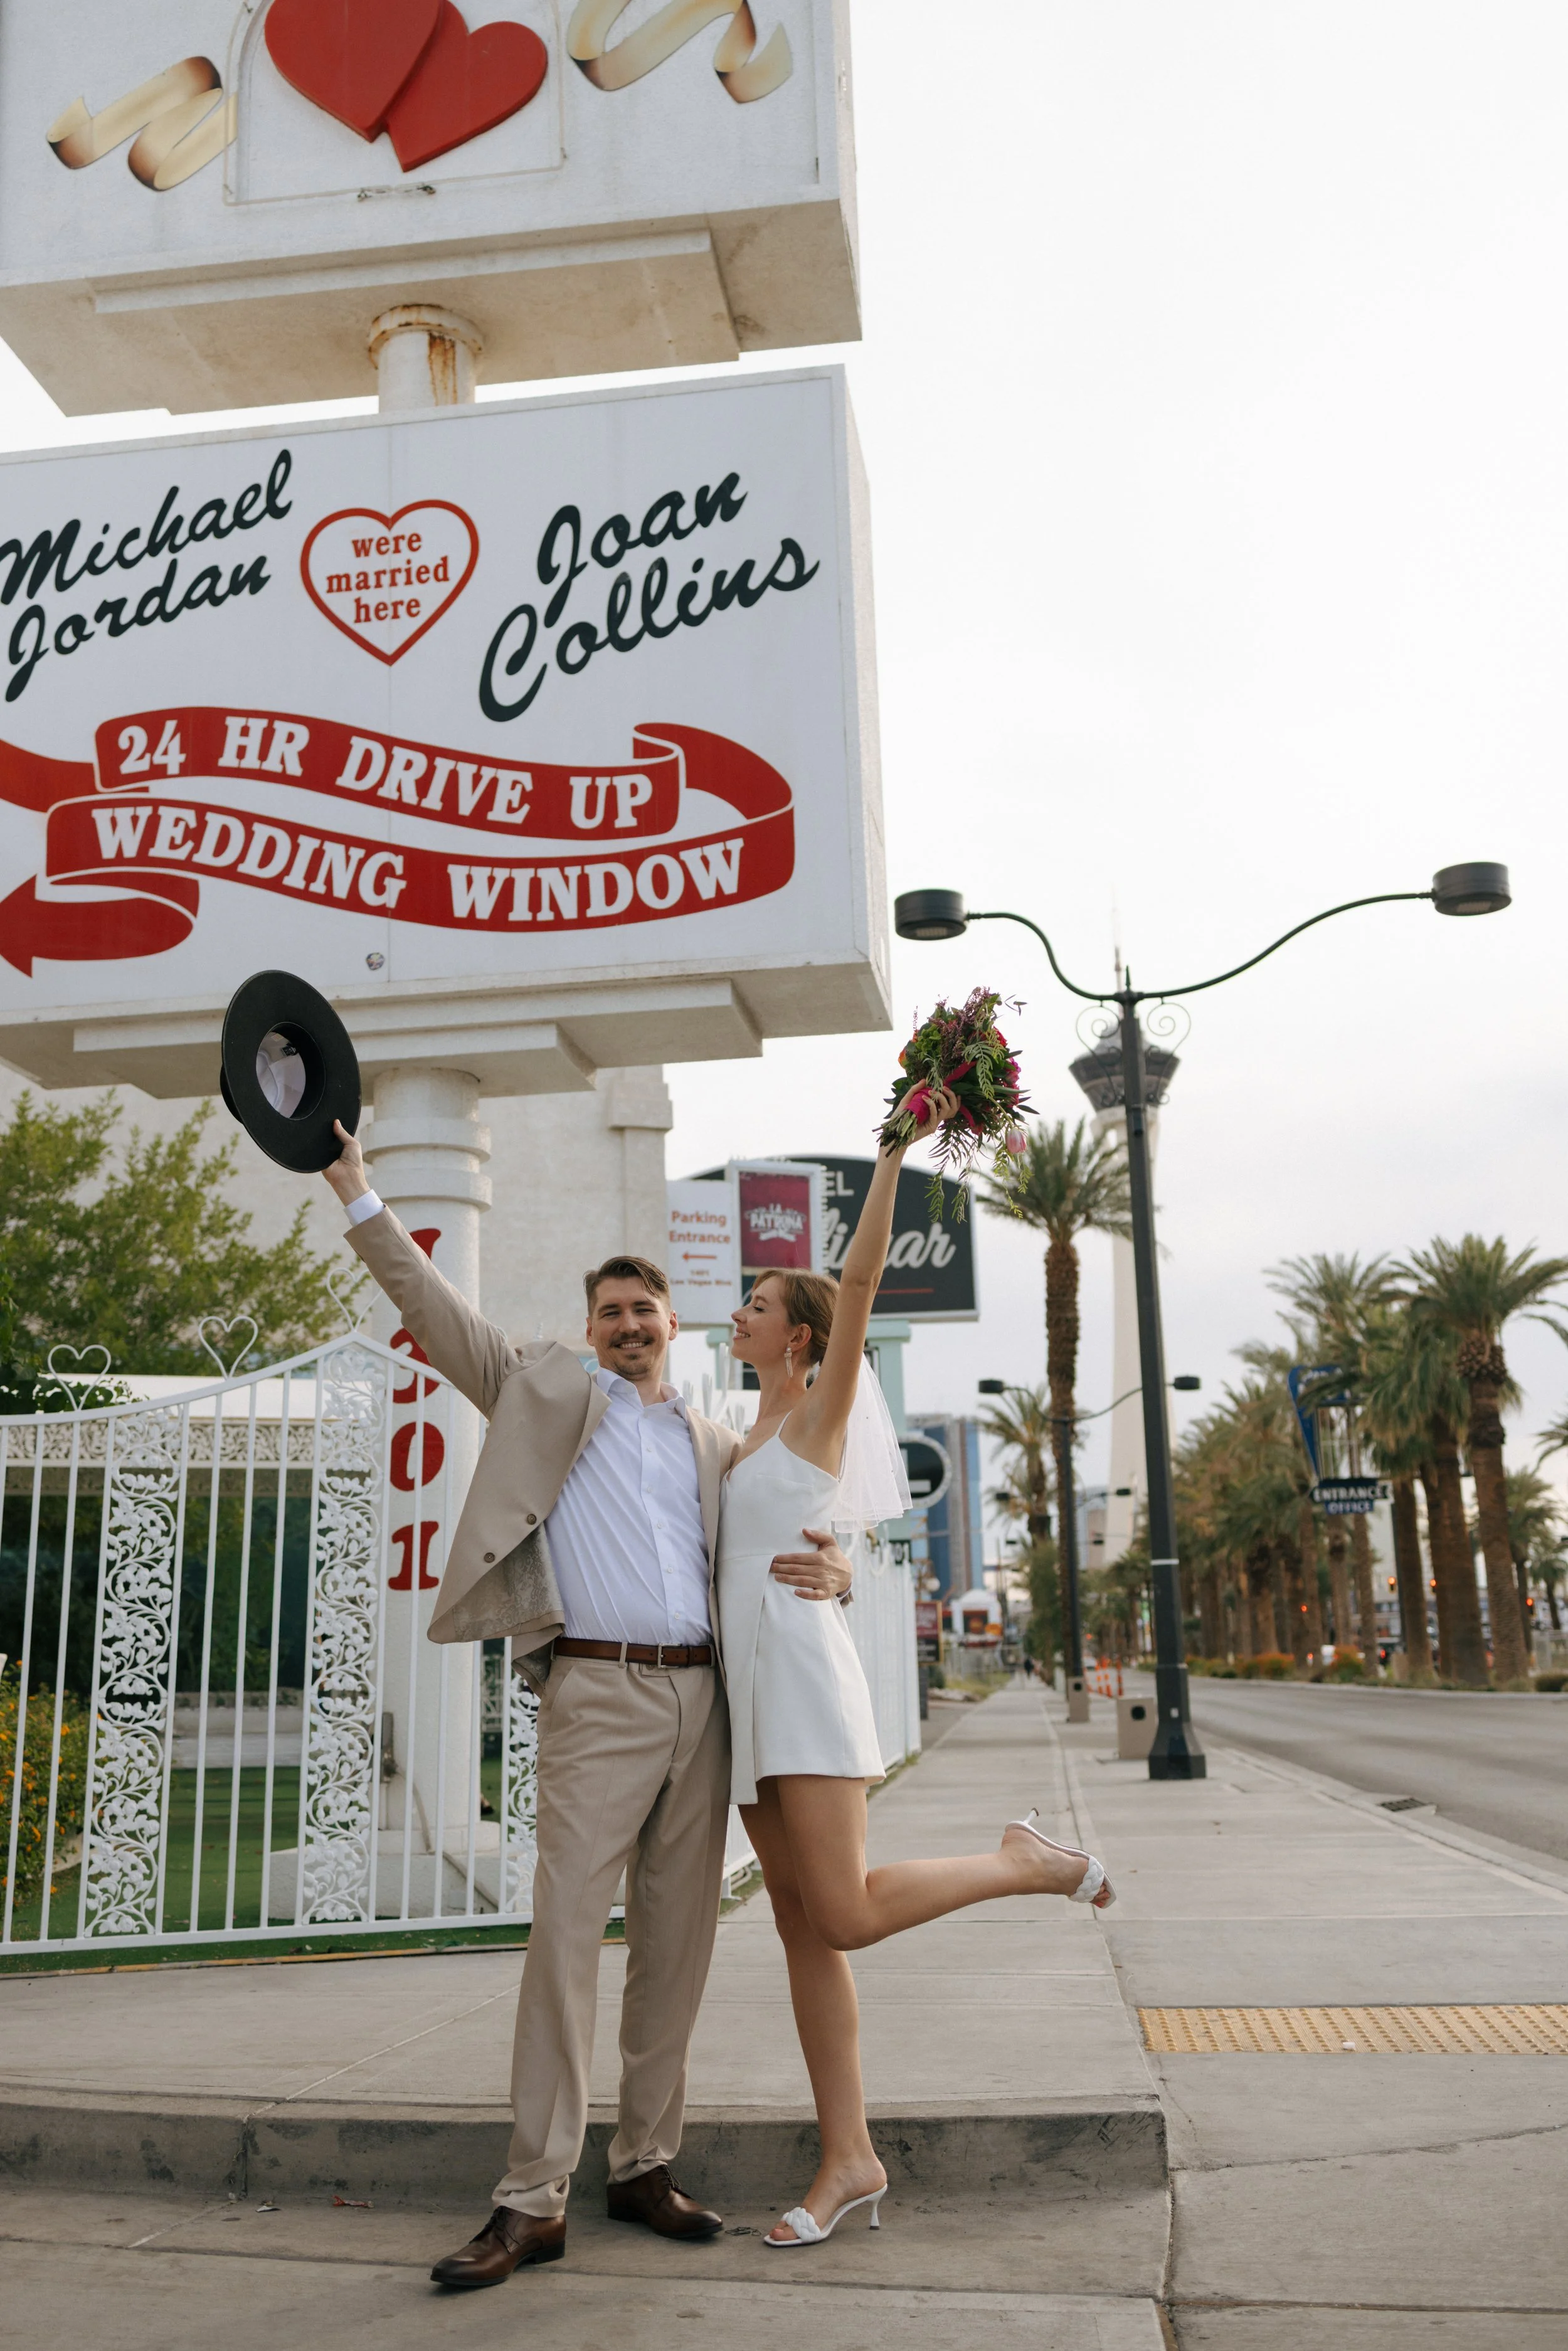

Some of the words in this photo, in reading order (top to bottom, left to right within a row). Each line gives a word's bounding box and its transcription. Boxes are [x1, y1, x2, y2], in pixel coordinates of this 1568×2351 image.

[0, 450, 292, 605] Michael
[352, 533, 421, 558] were
[538, 473, 747, 628] Joan
[327, 556, 449, 593] married
[354, 598, 420, 623] here
[6, 556, 270, 702] Jordan
[479, 538, 819, 722] Collins
[119, 720, 186, 774] 24
[218, 717, 309, 776] HR
[336, 736, 532, 823] DRIVE
[570, 774, 652, 828] UP
[92, 806, 406, 908] WEDDING
[448, 838, 743, 920] WINDOW
[669, 1231, 731, 1244] Entrance
[672, 1211, 726, 1228] Parking
[1313, 1485, 1382, 1502] ENTRANCE
